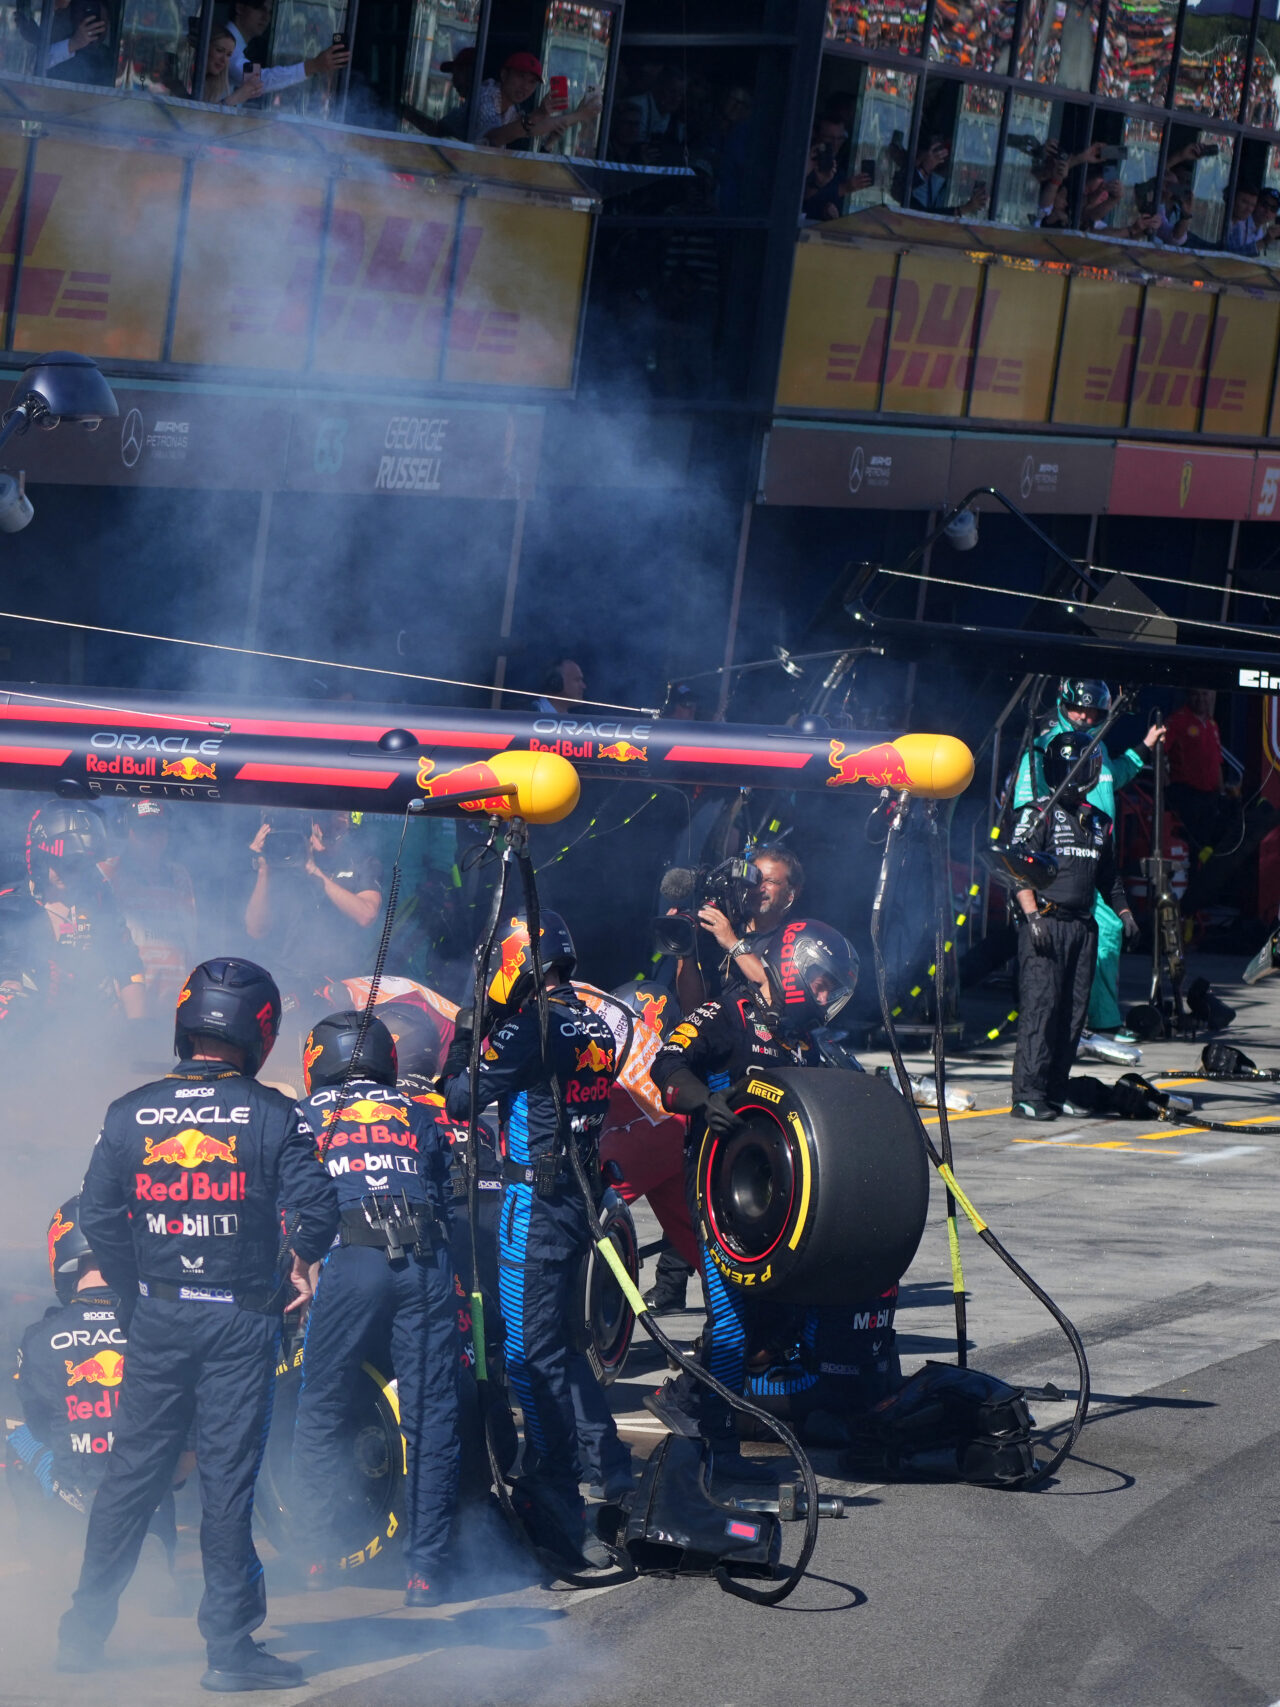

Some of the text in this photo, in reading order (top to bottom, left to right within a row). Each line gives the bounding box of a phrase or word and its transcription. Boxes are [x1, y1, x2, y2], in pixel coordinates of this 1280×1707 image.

[273, 204, 484, 351] DHL
[853, 276, 1001, 391] DHL
[1108, 307, 1228, 406] DHL
[146, 434, 189, 448] PETRONAS
[384, 416, 449, 452] GEORGE
[374, 455, 441, 490] RUSSELL
[533, 719, 652, 740] ORACLE
[90, 732, 223, 755] ORACLE
[529, 738, 593, 758] Red Bull
[86, 753, 157, 776] Red Bull
[88, 781, 221, 799] RACING
[780, 960, 806, 1004] Bull
[752, 1044, 772, 1056] Mobil
[746, 1079, 785, 1104] PIRELLI
[135, 1106, 251, 1124] ORACLE
[327, 1152, 394, 1178] Mobil
[135, 1172, 246, 1201] Red Bull
[146, 1213, 210, 1236] Mobil
[709, 1247, 756, 1286] ZERO
[760, 1264, 772, 1283] P
[180, 1285, 234, 1303] sparco
[83, 1310, 116, 1320] sparc
[853, 1308, 889, 1330] Mobil
[50, 1328, 127, 1350] ORAC
[65, 1390, 113, 1422] Red
